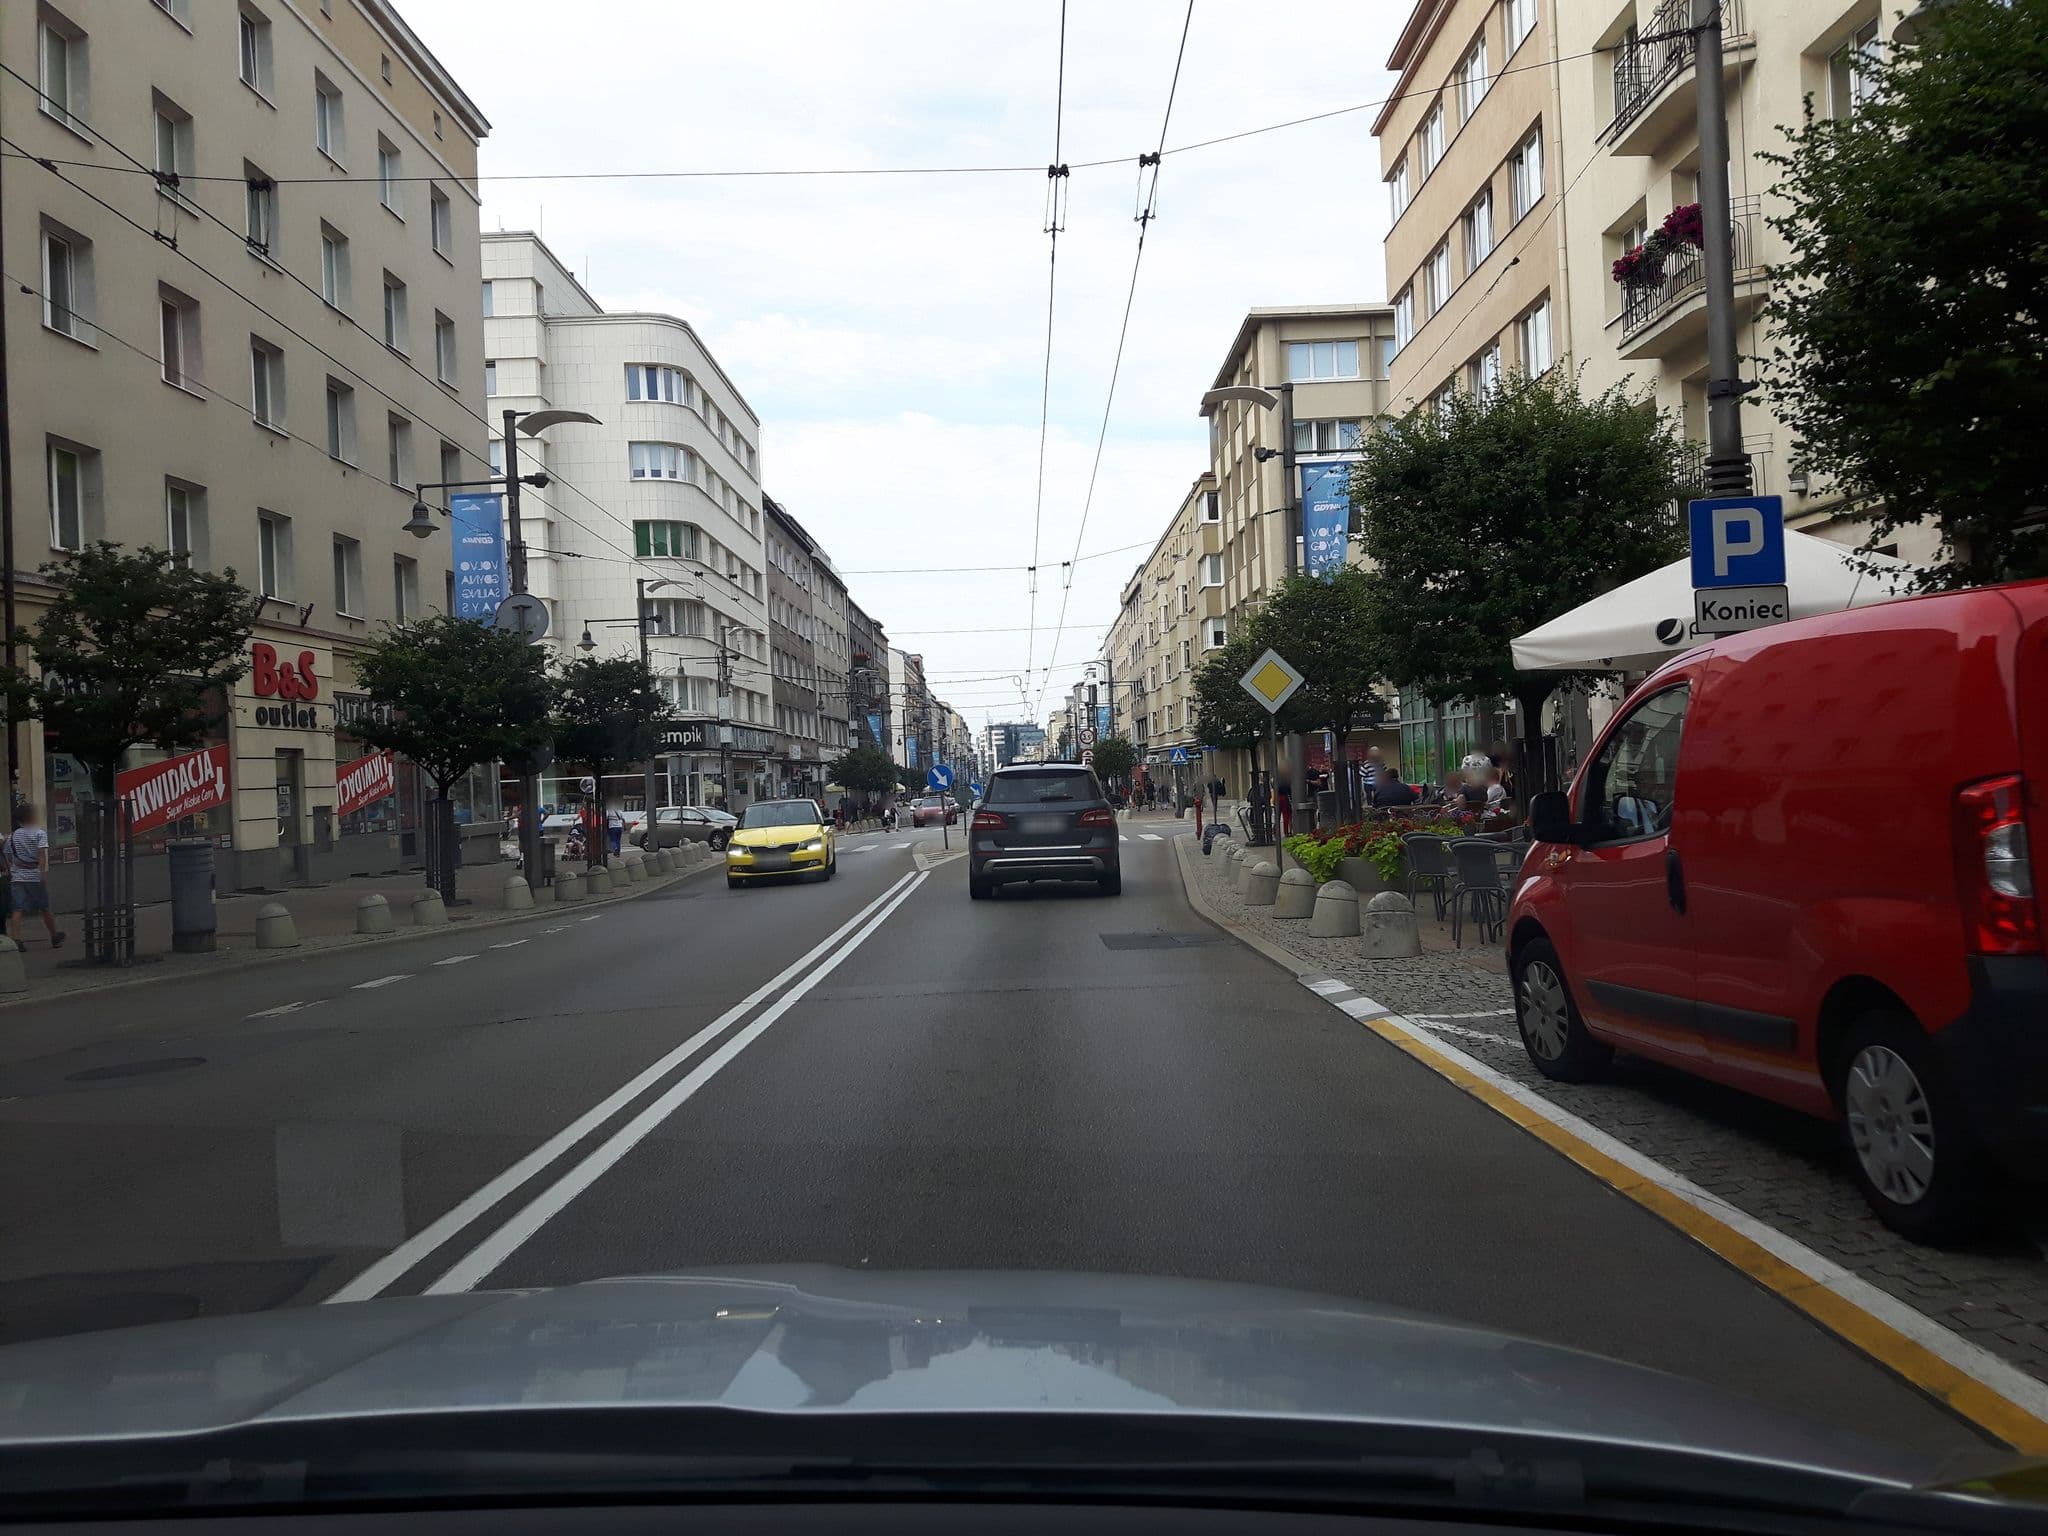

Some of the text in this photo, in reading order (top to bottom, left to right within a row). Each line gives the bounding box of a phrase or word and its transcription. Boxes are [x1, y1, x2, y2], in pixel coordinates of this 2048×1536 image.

[1712, 507, 1764, 577] P
[1702, 599, 1784, 621] Koniec
[252, 643, 318, 701] B&S
[256, 703, 317, 729] outlet
